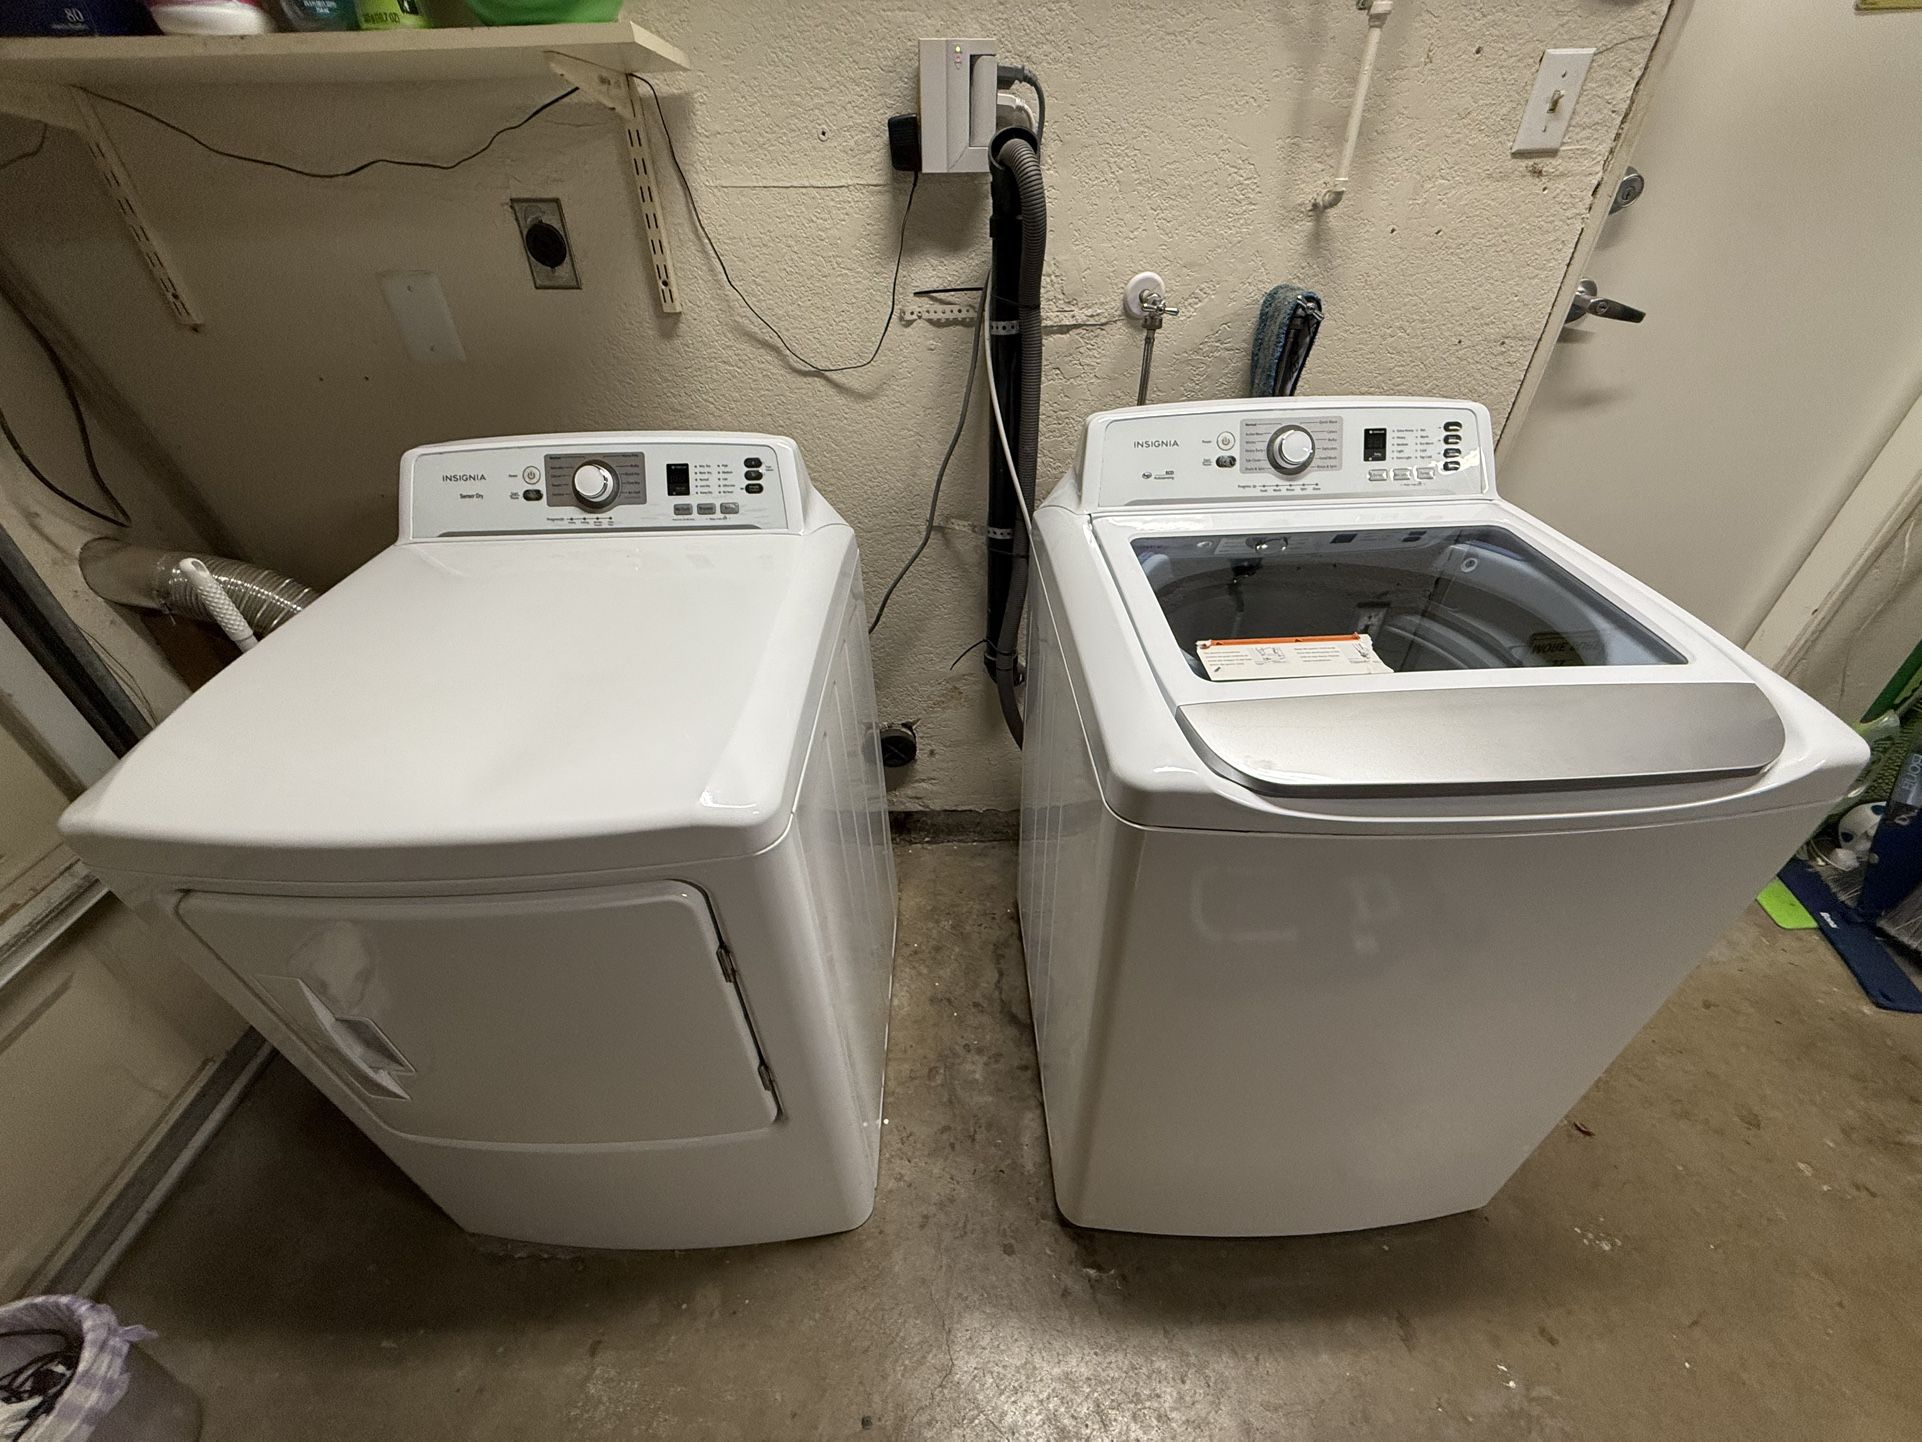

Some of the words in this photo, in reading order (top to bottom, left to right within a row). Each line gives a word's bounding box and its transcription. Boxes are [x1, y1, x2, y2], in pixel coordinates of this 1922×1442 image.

[1133, 440, 1180, 449] INSIGNIA
[442, 473, 487, 482] INSIGNIA
[476, 492, 484, 500] Dry
